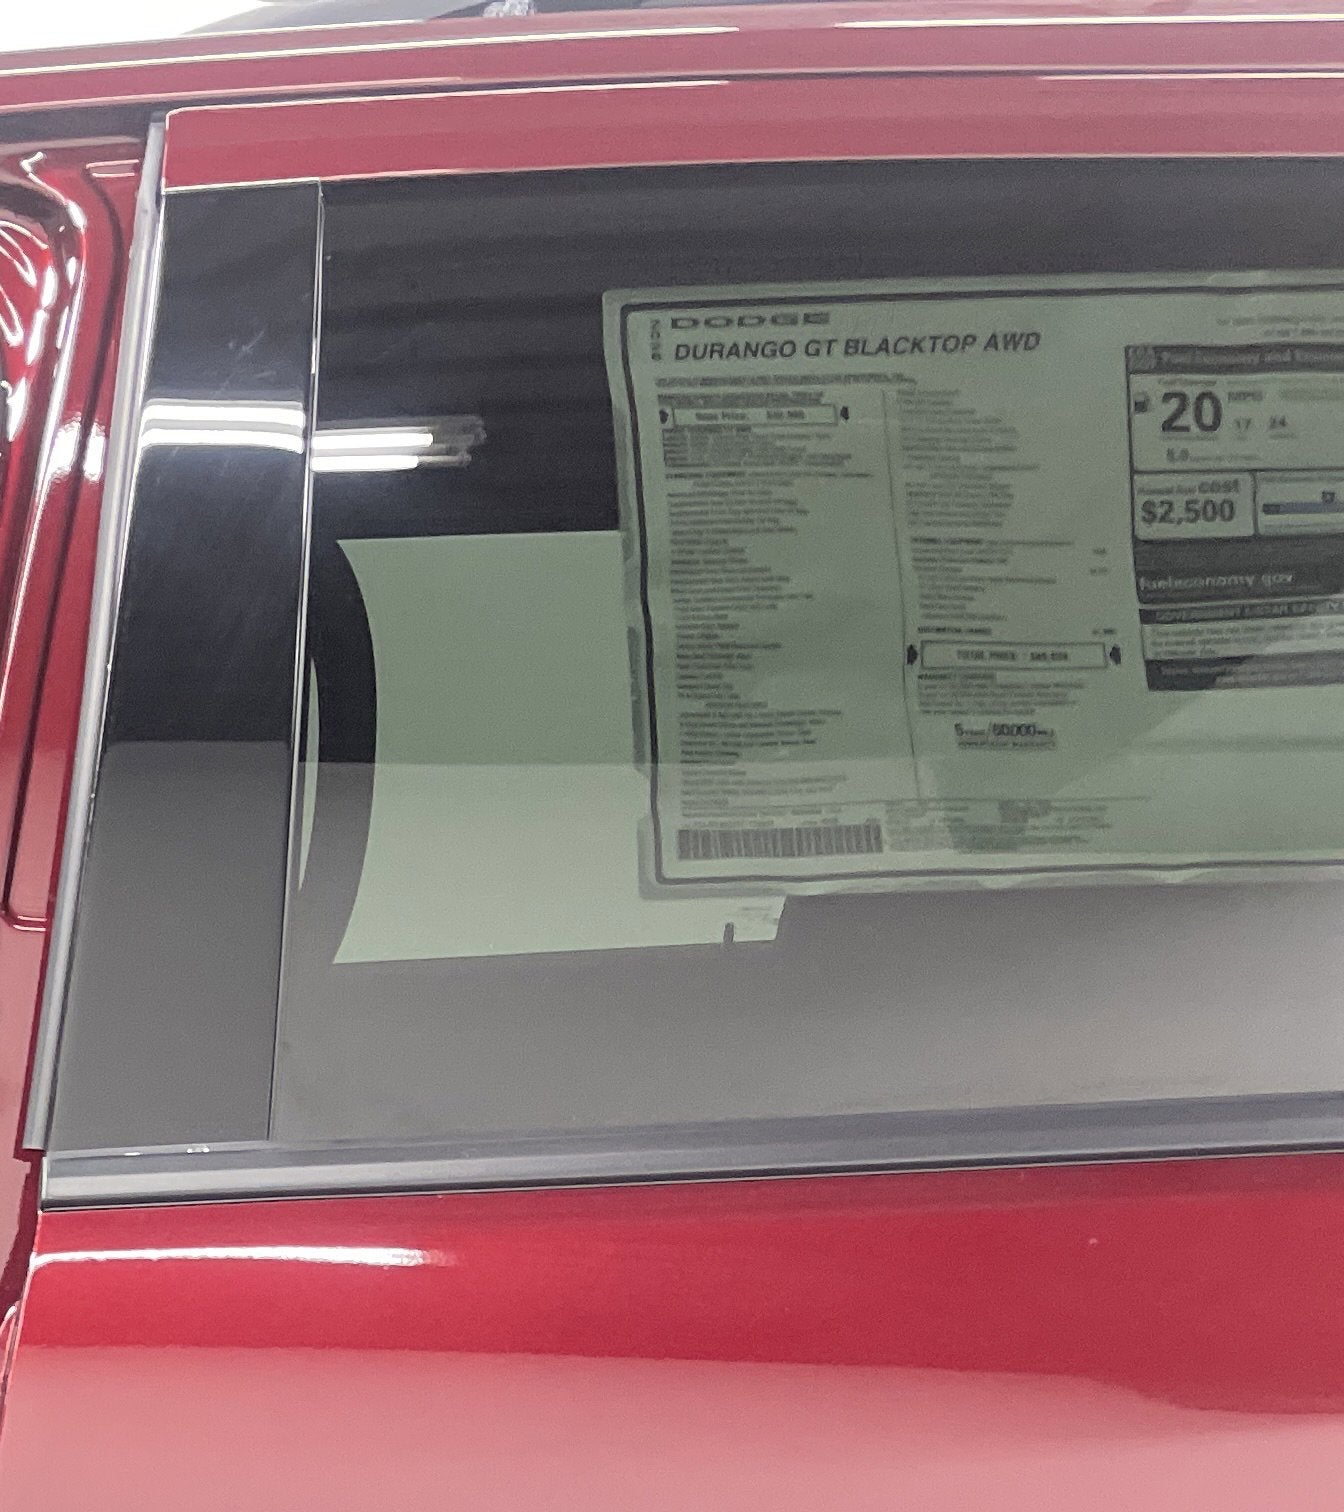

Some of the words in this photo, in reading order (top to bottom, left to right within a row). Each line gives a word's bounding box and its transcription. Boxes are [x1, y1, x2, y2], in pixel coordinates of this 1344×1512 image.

[671, 312, 830, 330] DODGE
[675, 340, 796, 361] DURANGO
[804, 338, 838, 358] GT
[843, 333, 977, 357] BLACKTOP
[983, 331, 1041, 353] AWD
[1161, 390, 1223, 432] 20
[1141, 497, 1236, 526] $2,500
